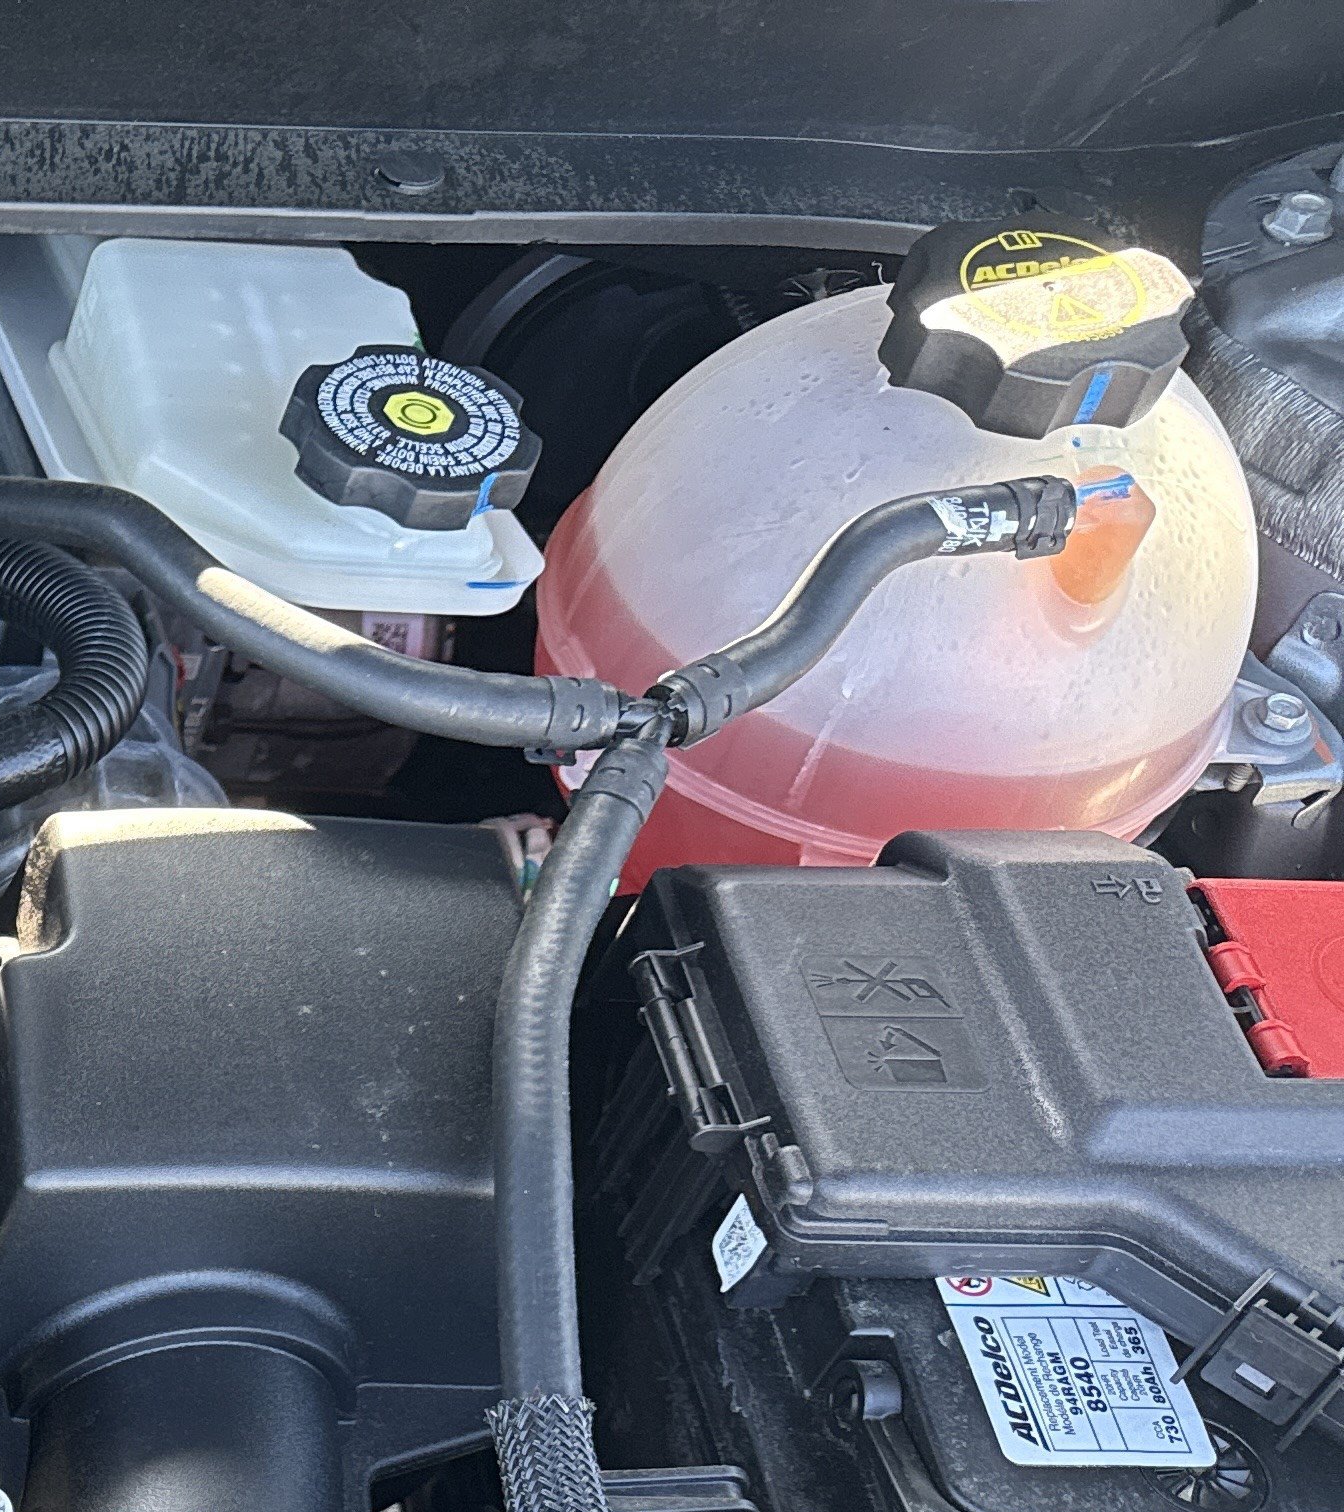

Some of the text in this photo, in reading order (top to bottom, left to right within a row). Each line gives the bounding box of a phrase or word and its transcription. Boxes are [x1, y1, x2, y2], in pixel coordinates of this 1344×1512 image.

[385, 353, 417, 365] DOT4
[396, 364, 419, 375] CAP
[483, 389, 519, 427] NETTOYER
[353, 427, 383, 447] ONLY
[504, 427, 519, 439] LE
[379, 443, 415, 463] DOT4
[418, 453, 455, 465] FREIN
[425, 464, 445, 476] LA
[448, 461, 483, 477] AVANT
[1123, 1326, 1145, 1355] 365
[1027, 1332, 1054, 1381] Rechange
[972, 1315, 1039, 1446] ACDelco
[1012, 1335, 1061, 1432] Replacement Model
[1046, 1350, 1083, 1415] 94RAGM
[1048, 1383, 1060, 1397] de
[1069, 1356, 1108, 1413] 8540
[1140, 1366, 1166, 1404] 80Ah
[1151, 1420, 1165, 1439] CCA
[1161, 1415, 1183, 1443] 730
